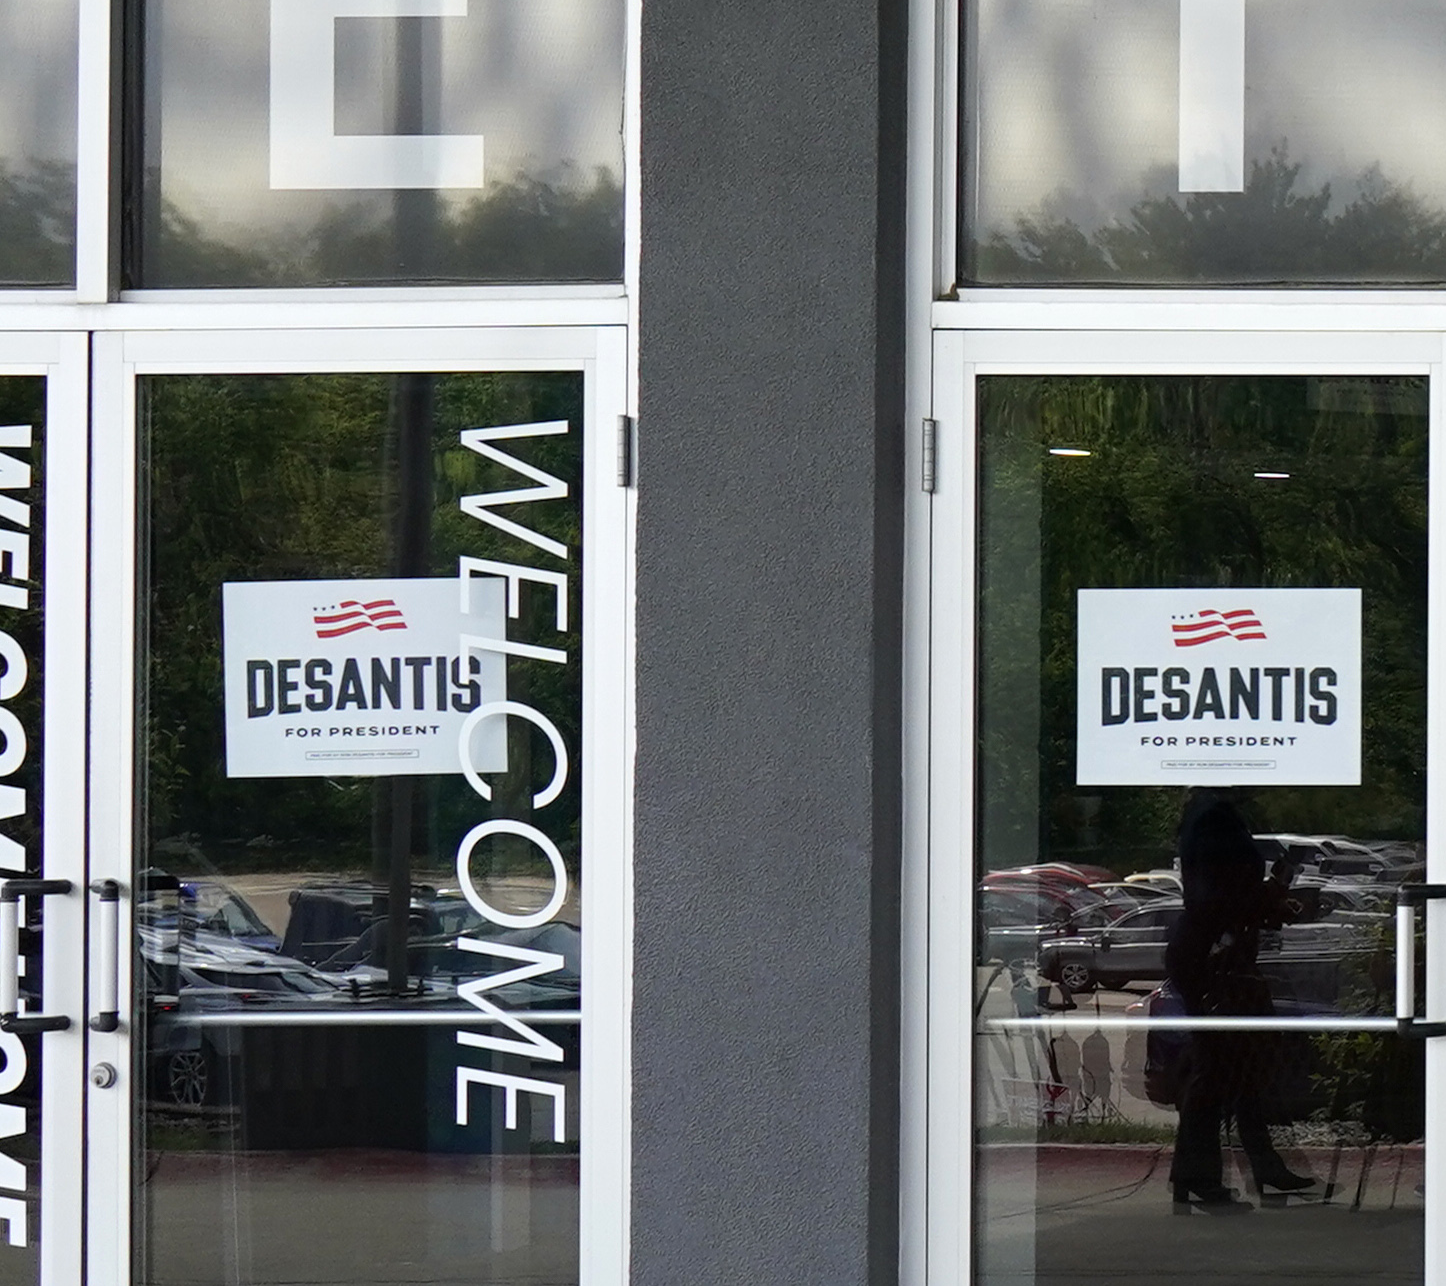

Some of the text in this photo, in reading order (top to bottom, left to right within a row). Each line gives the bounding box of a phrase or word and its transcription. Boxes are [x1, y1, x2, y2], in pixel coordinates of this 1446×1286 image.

[246, 655, 482, 720] DESANTIS
[1101, 667, 1338, 727] DESANTIS
[285, 725, 440, 738] FOR PRESIDENT
[1141, 736, 1297, 747] FOR PRESIDENT
[456, 419, 570, 1144] WELCOME
